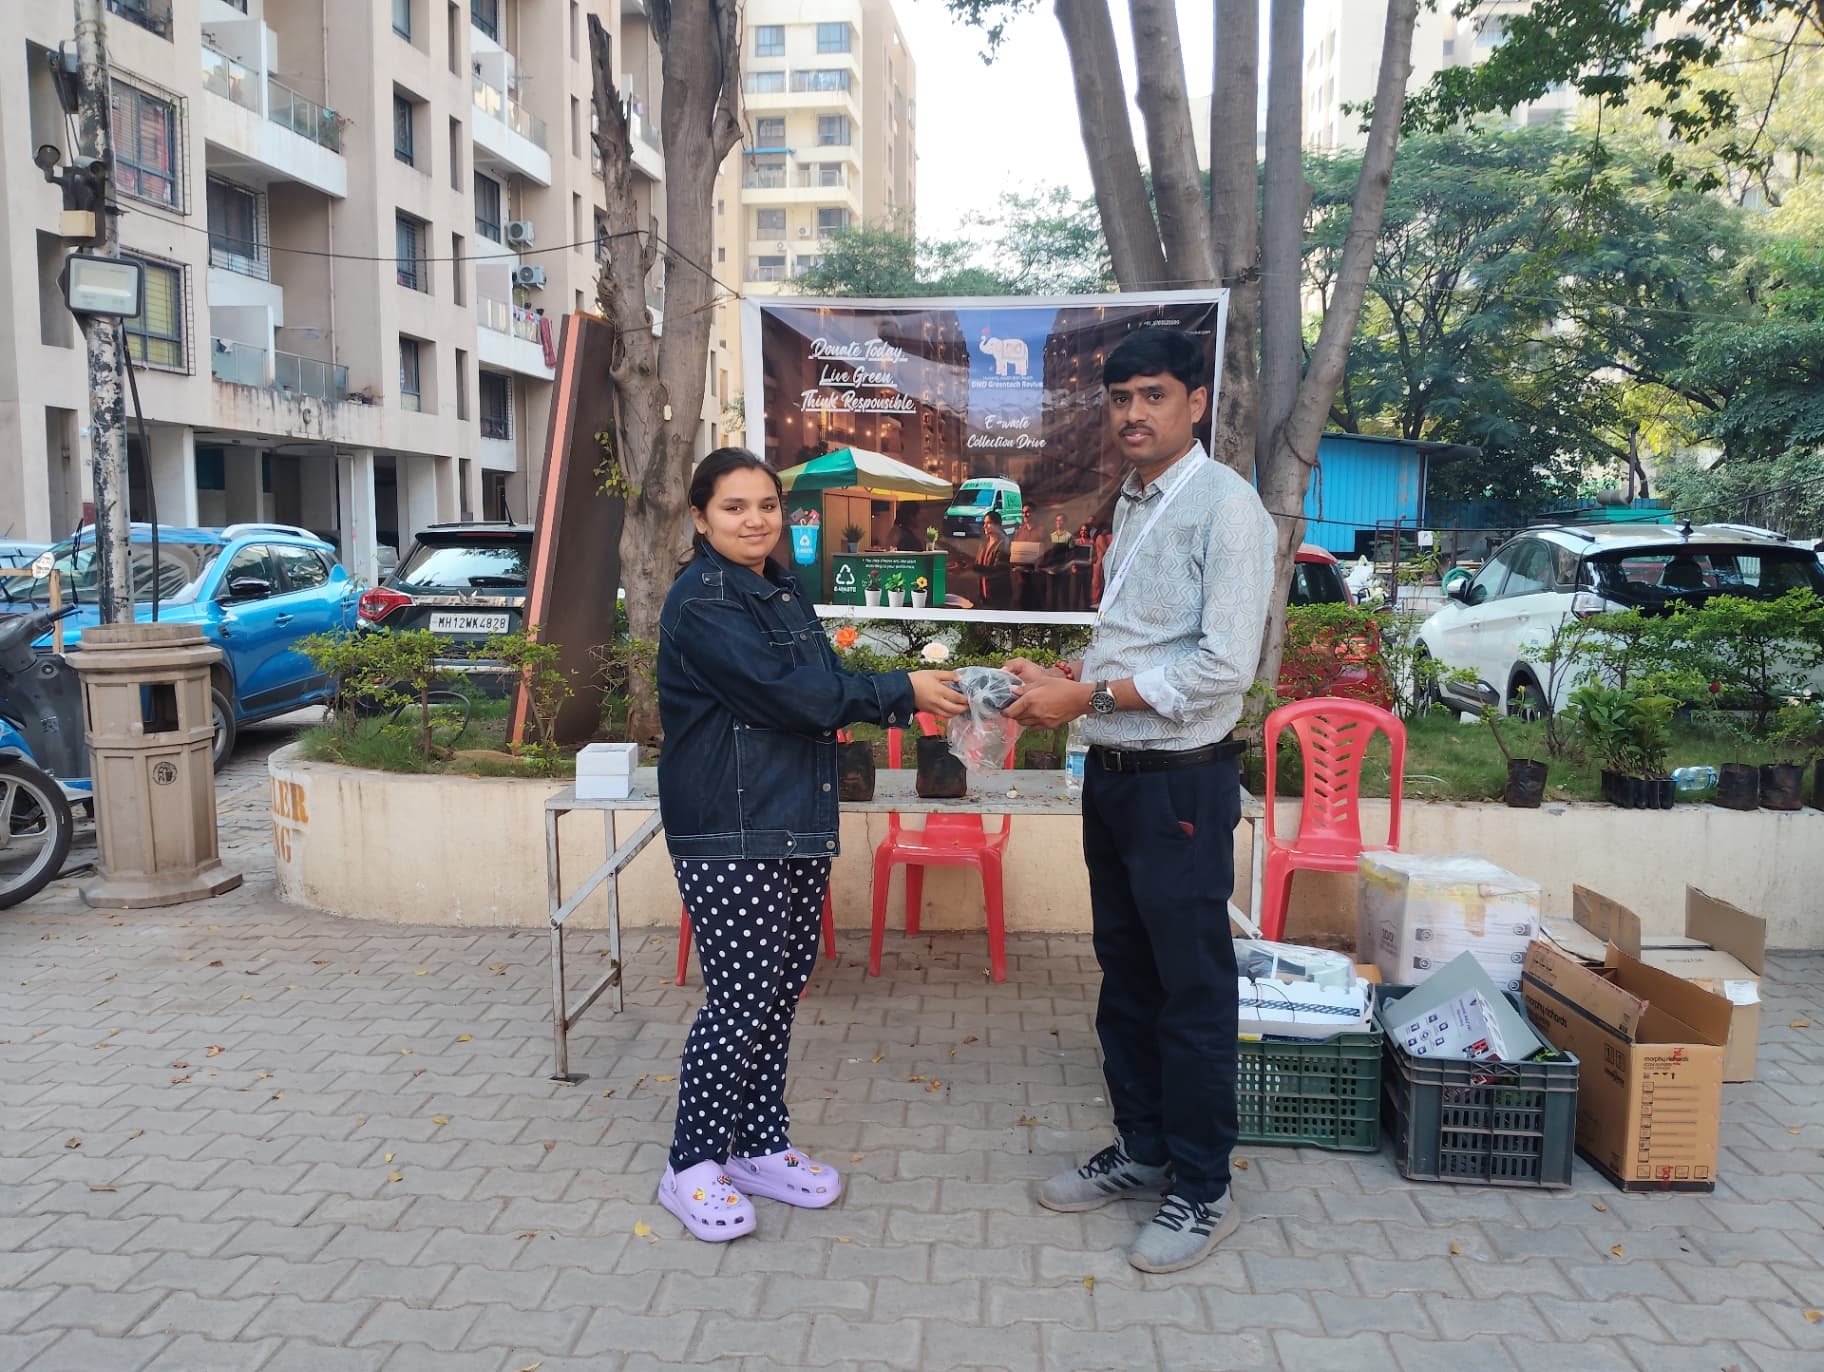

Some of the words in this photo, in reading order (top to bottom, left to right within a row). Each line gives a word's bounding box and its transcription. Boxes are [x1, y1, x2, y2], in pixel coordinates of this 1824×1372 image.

[810, 337, 862, 360] Donate
[863, 338, 905, 363] Today.
[819, 363, 850, 386] Live
[801, 388, 839, 412] Think
[967, 433, 1014, 449] Collection
[1016, 433, 1047, 449] Drive
[438, 616, 507, 629] MH12WK4828
